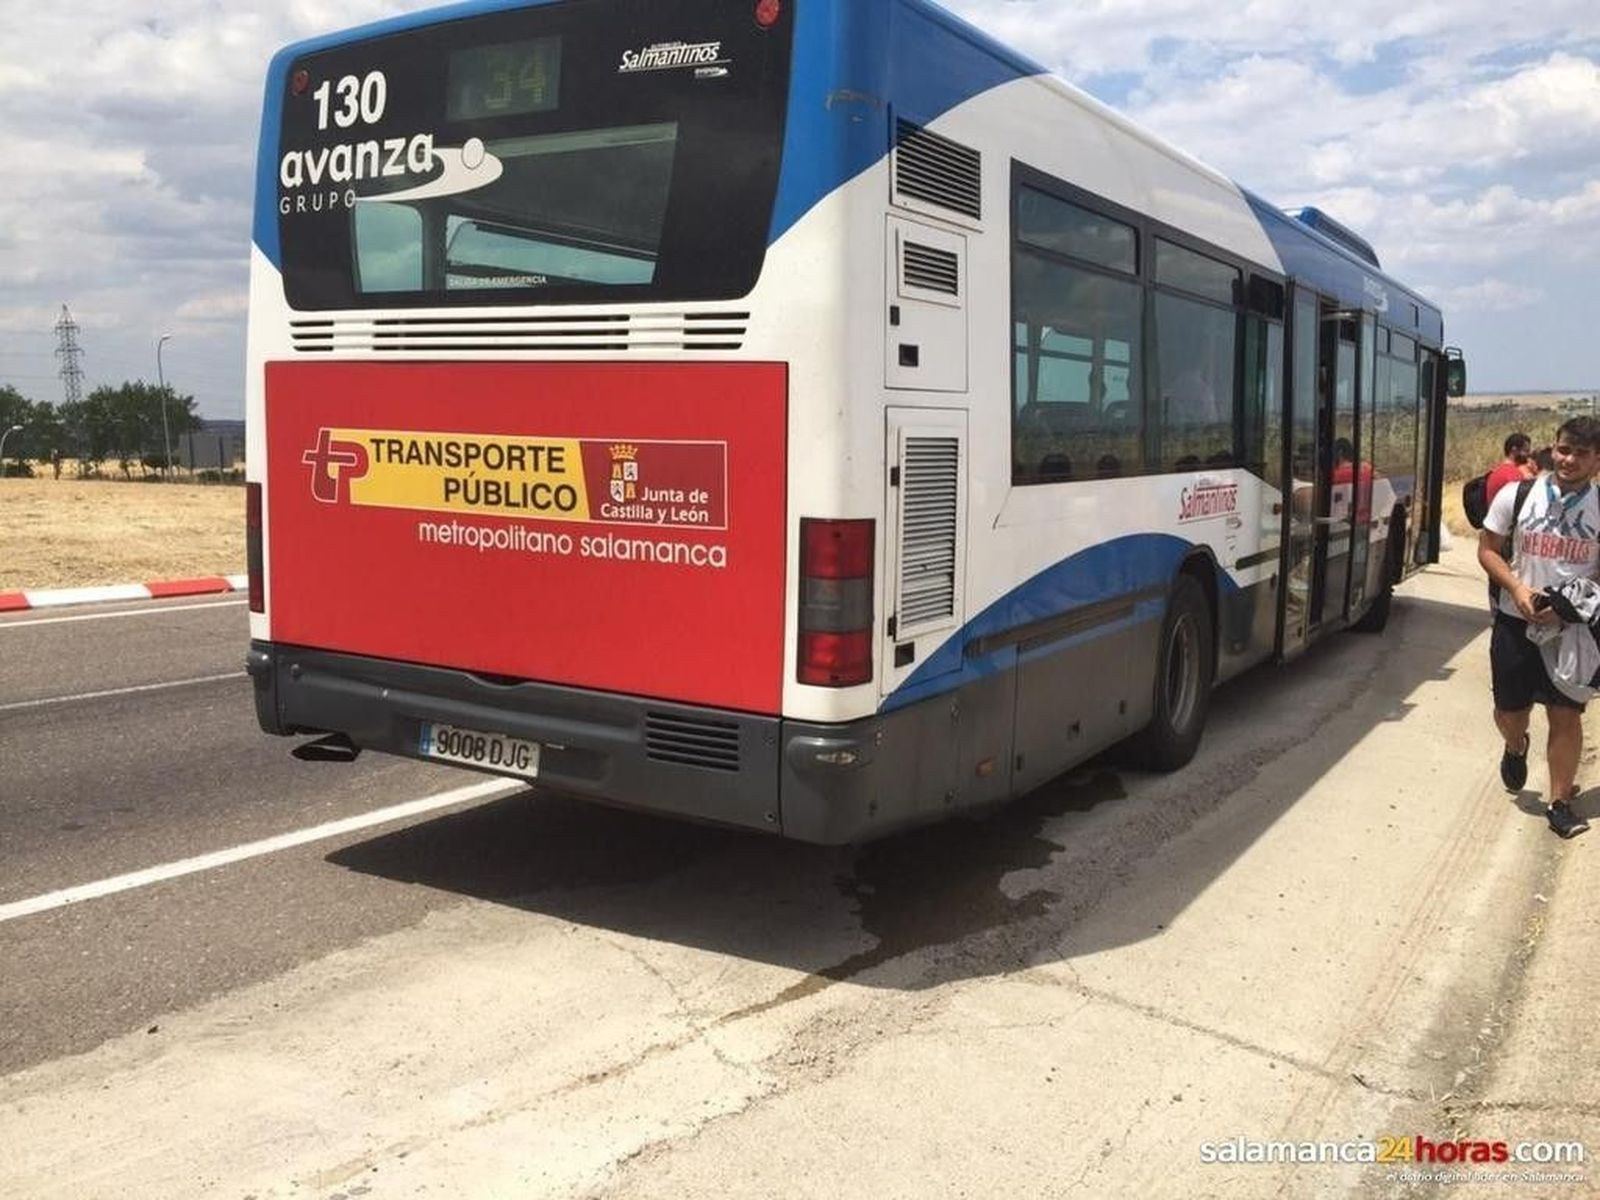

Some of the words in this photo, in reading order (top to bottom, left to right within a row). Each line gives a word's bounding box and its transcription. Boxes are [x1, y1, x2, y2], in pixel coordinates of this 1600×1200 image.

[619, 42, 720, 69] Salmantinos
[313, 70, 387, 130] 130
[280, 133, 434, 188] avanza
[280, 189, 356, 214] GRUPO
[370, 438, 566, 474] TRANSPORTE
[444, 471, 578, 512] PÚBLICO
[641, 486, 684, 502] Junta
[688, 489, 708, 504] de
[600, 503, 653, 519] Castilla
[658, 508, 667, 524] y
[671, 506, 708, 522] León
[418, 520, 573, 555] metropolitano
[579, 532, 727, 568] salamanca
[437, 730, 486, 761] 9008
[489, 739, 530, 770] DJG
